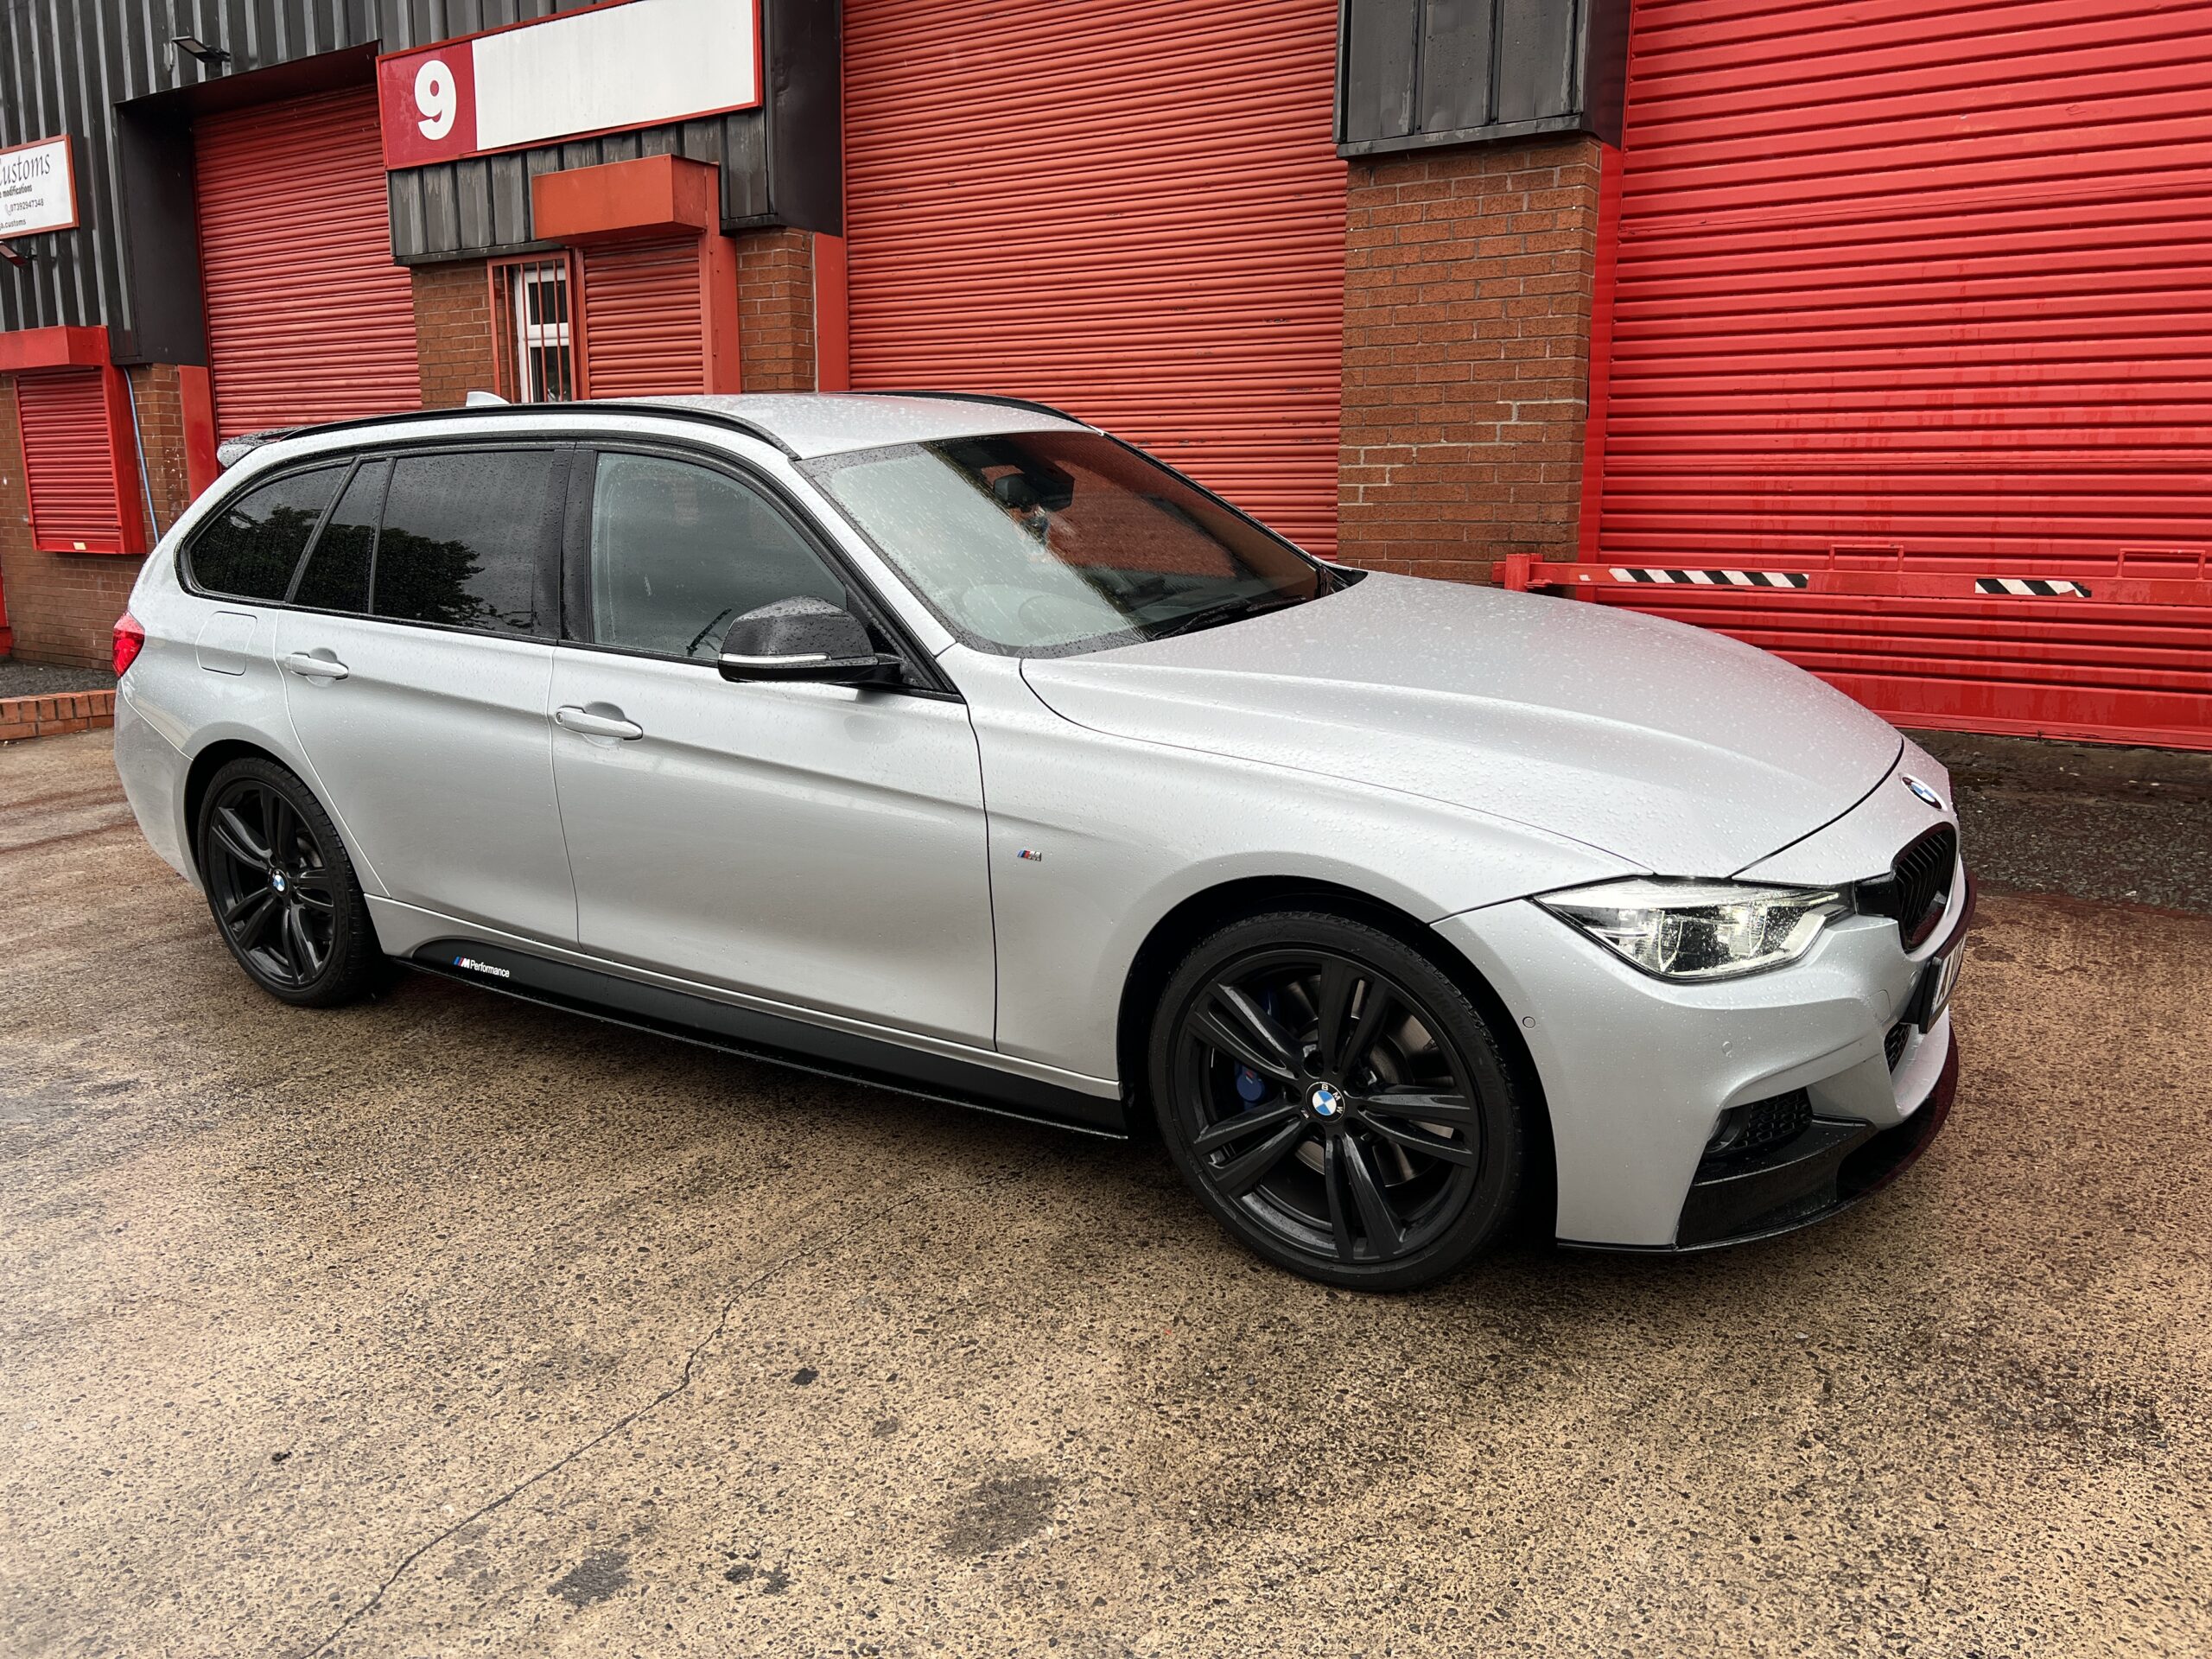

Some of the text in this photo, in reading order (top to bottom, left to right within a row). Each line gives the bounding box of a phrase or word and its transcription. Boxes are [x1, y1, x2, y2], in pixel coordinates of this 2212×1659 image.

[414, 60, 457, 141] 9
[3, 184, 33, 197] modifications
[1321, 1084, 1344, 1114] BMW
